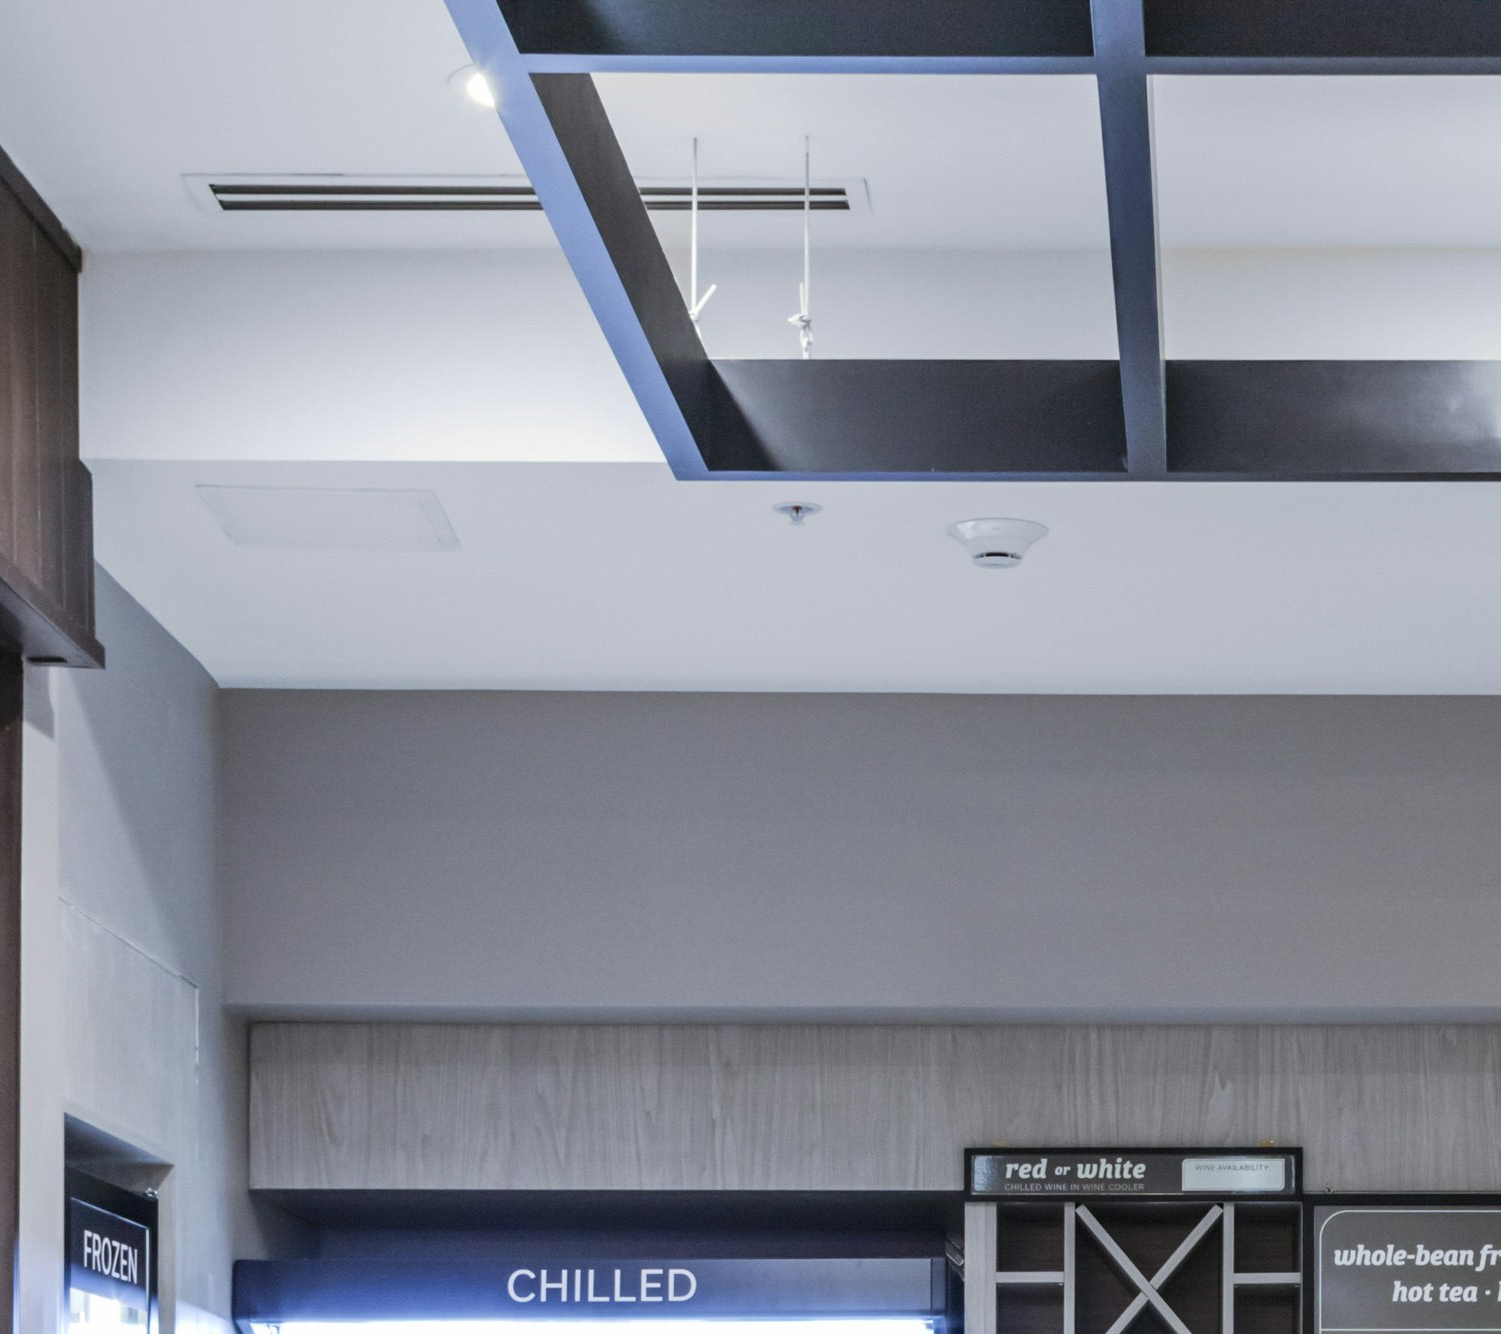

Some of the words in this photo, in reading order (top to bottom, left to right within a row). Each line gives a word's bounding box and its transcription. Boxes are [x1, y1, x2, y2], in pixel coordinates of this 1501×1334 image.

[1005, 1158, 1047, 1179] red
[1054, 1165, 1071, 1176] or
[1077, 1158, 1147, 1179] white
[1005, 1183, 1042, 1191] CHILLED
[1044, 1183, 1068, 1191] WINE
[1070, 1183, 1080, 1191] IN
[1082, 1183, 1106, 1191] WINE
[1108, 1183, 1145, 1191] COOLER
[83, 1229, 138, 1285] FROZEN
[1333, 1242, 1475, 1268] whole-bean
[507, 1267, 698, 1304] CHILLED
[1392, 1279, 1431, 1305] hot
[1437, 1282, 1479, 1305] tea
